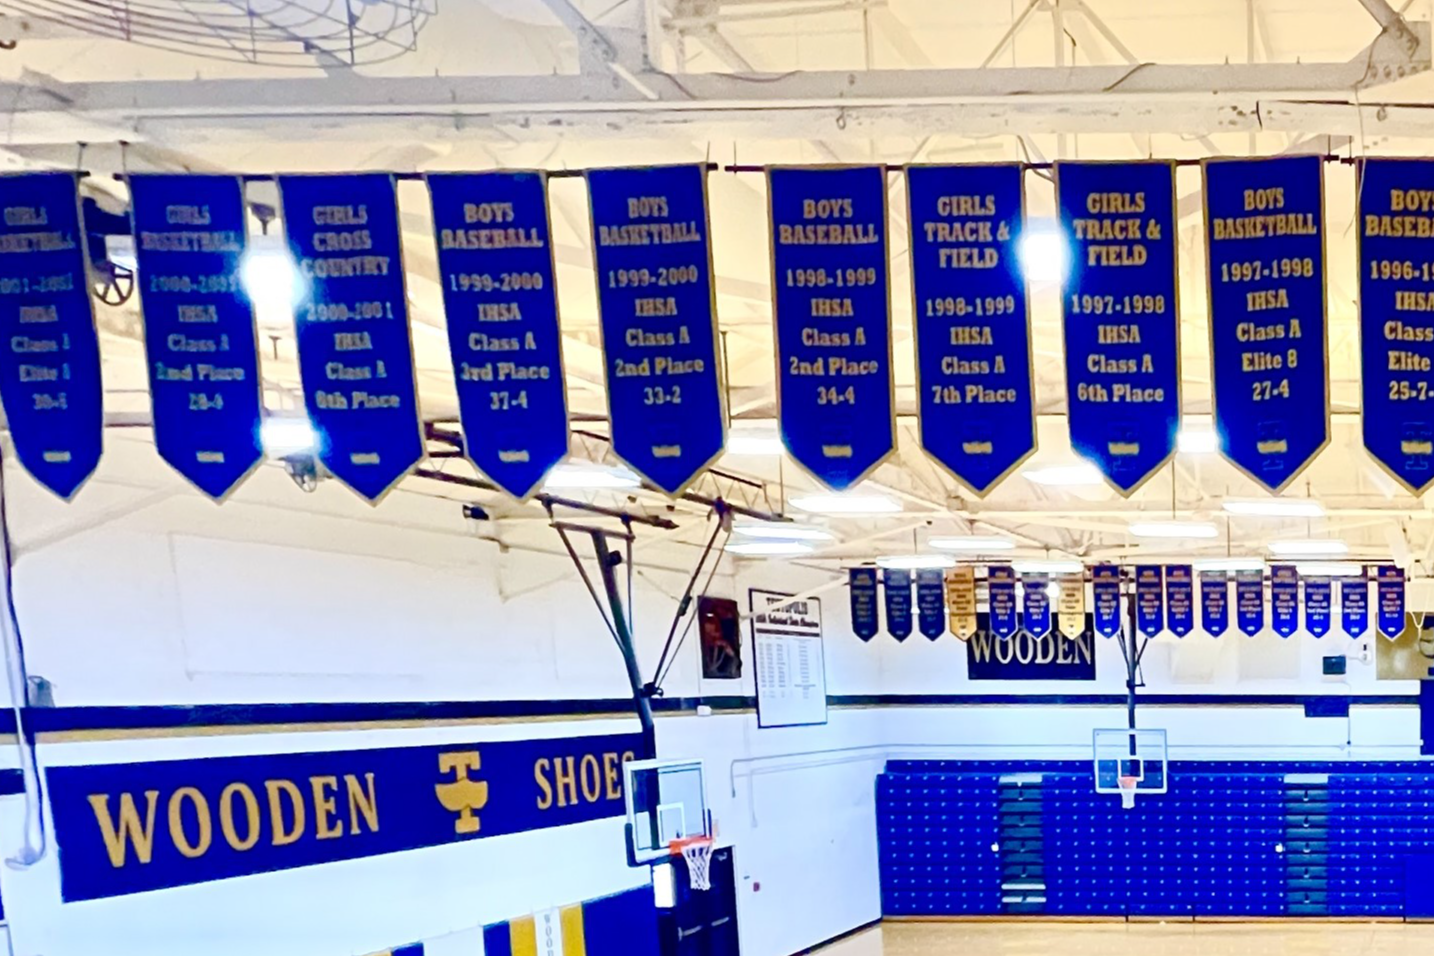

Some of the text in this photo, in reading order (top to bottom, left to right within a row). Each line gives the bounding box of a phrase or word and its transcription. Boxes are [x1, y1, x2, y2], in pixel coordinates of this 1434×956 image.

[628, 197, 668, 218] BOYS
[804, 199, 852, 219] BOYS
[938, 196, 995, 216] GIRLS
[1087, 192, 1145, 213] GIRLS
[1244, 188, 1284, 210] BOYS
[464, 203, 514, 223] BOYS
[599, 221, 701, 246] BASKETBALL
[779, 224, 878, 244] BASEBALL
[924, 221, 1010, 242] TRACK &
[1073, 219, 1160, 240] TRACK &
[1214, 214, 1316, 240] BASKETBALL
[442, 228, 543, 249] BASEBALL
[939, 248, 998, 268] FIELD
[1088, 245, 1147, 266] FIELD
[610, 265, 698, 287] 1999-2000
[787, 268, 876, 287] 1998-1999
[1222, 258, 1313, 281] 1997-1998
[450, 273, 543, 291] 1999-2000
[635, 297, 677, 316] IHSA
[811, 299, 853, 316] IHSA
[927, 295, 1014, 316] 1998-1999
[1072, 294, 1164, 314] 1997-1998
[1247, 289, 1288, 311] IHSA
[478, 303, 521, 321] IHSA
[626, 326, 690, 346] Class A
[802, 327, 866, 346] Class A
[951, 327, 993, 344] IHSA
[1098, 325, 1140, 343] IHSA
[1237, 319, 1301, 342] Class A
[1384, 321, 1434, 341] Class
[469, 332, 536, 351] Class A
[616, 357, 704, 377] 2nd Place
[790, 357, 878, 375] 2nd Place
[942, 356, 1005, 374] Class A
[1087, 354, 1153, 373] Class A
[1242, 349, 1297, 371] Elite 8
[1388, 351, 1430, 371] Elite
[497, 362, 549, 380] Place
[644, 386, 681, 404] 33-2
[818, 386, 854, 404] 34-4
[932, 385, 1016, 403] 7th Place
[1078, 383, 1163, 402] 6th Place
[1253, 379, 1289, 400] 27-4
[490, 391, 527, 410] 37-4
[971, 629, 1092, 665] WOODEN
[88, 772, 380, 869] WOODEN
[534, 751, 635, 810] SHOE
